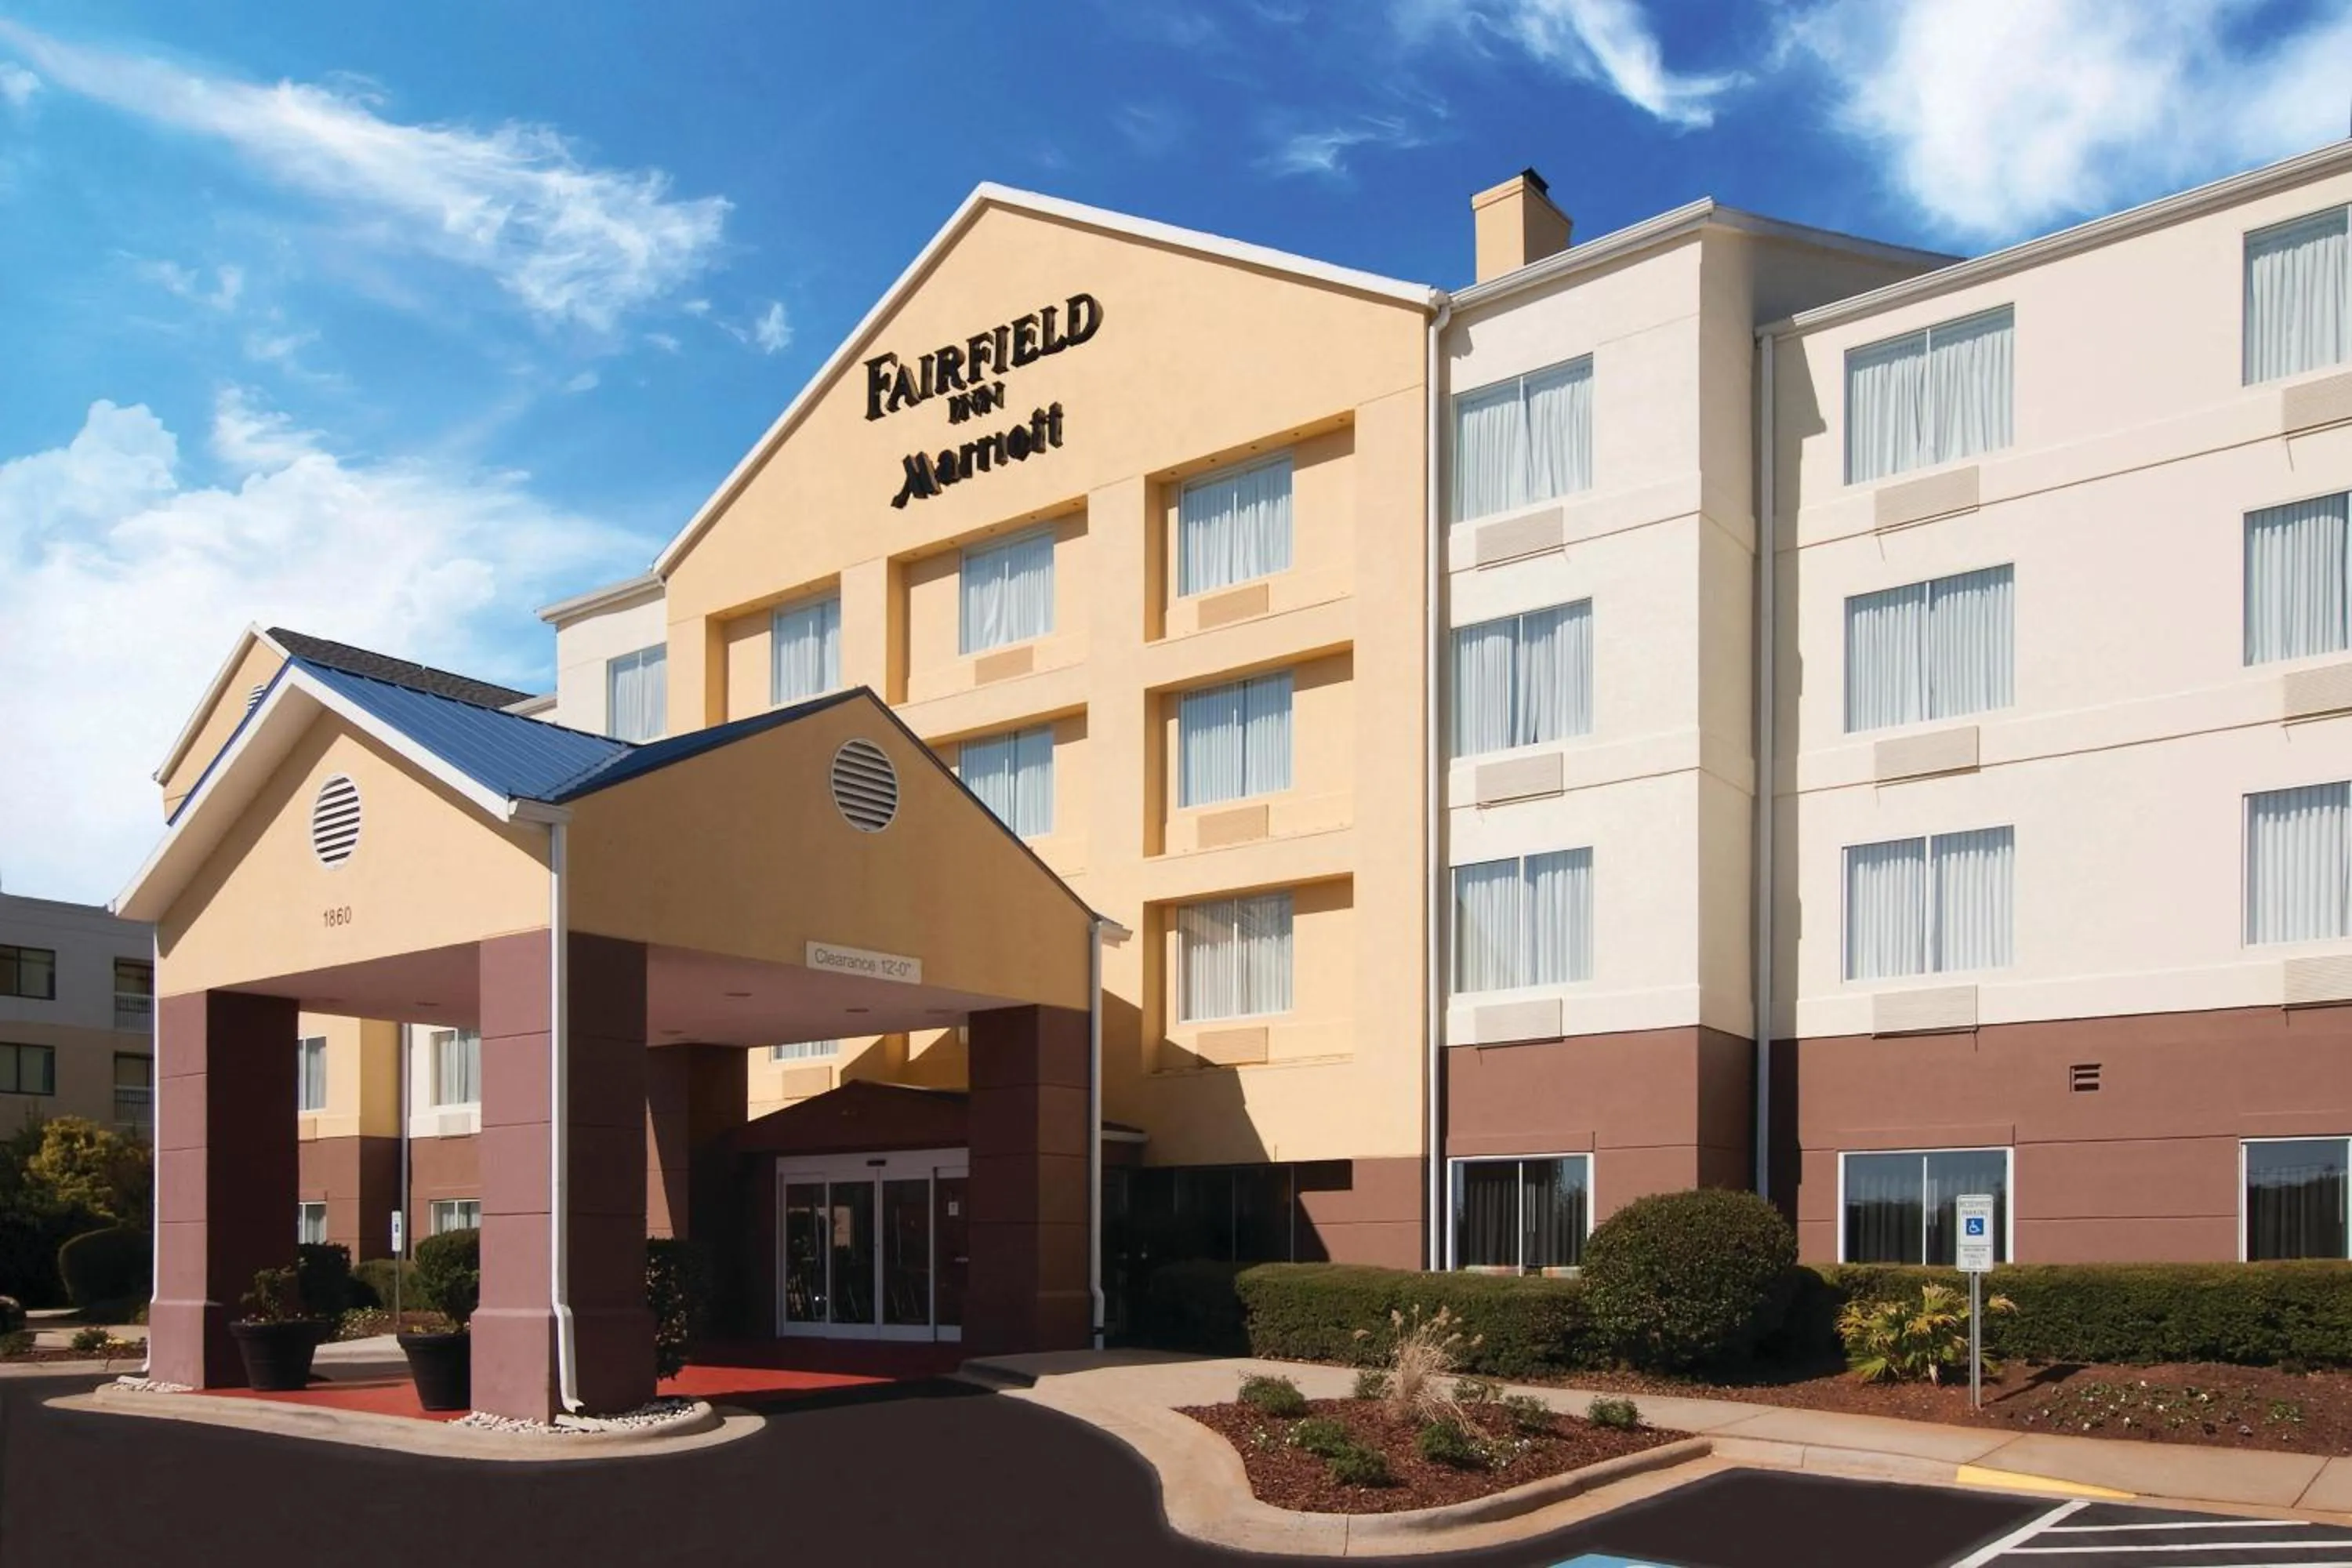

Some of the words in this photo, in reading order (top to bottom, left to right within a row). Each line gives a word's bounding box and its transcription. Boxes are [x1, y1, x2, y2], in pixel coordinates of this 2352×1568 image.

[864, 293, 1104, 422] FAIRFIELD
[947, 381, 1006, 425] INN
[891, 401, 1064, 509] Marriott
[323, 906, 352, 928] 1860
[814, 948, 876, 972] Clearance
